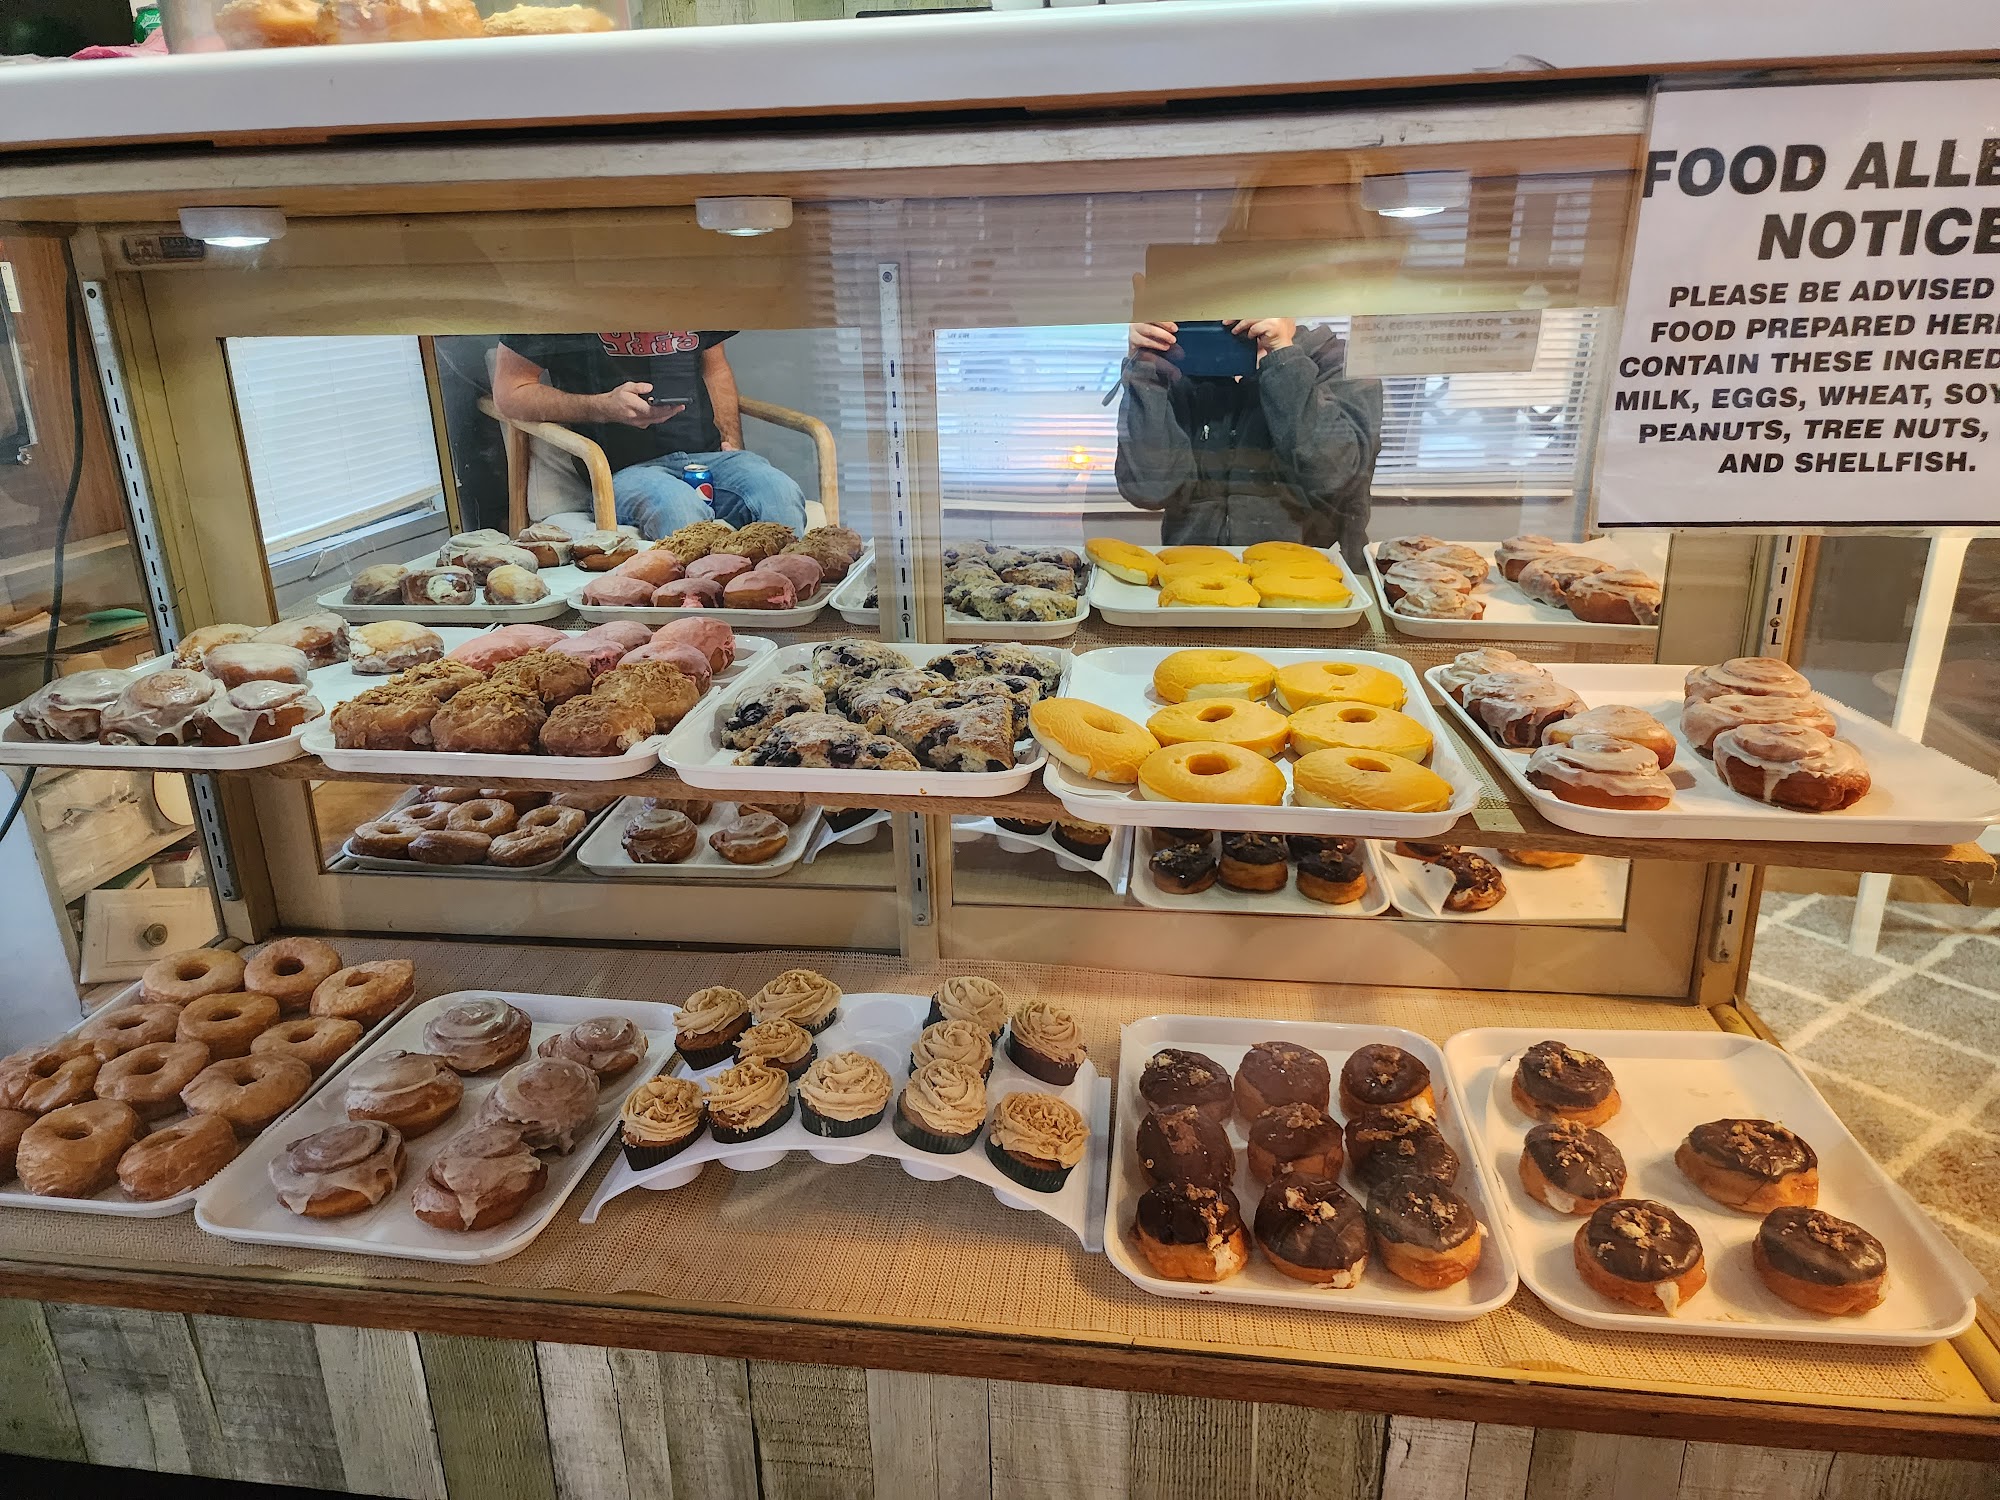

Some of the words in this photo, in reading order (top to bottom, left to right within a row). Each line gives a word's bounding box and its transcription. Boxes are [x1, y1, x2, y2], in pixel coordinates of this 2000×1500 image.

[1642, 143, 1827, 198] FOOD
[1844, 138, 2000, 190] ALLE
[1757, 206, 2000, 261] NOTICE
[1668, 282, 1789, 308] PLEASE
[1798, 281, 1841, 303] BE
[1849, 277, 1995, 301] ADVISED
[1650, 319, 1736, 343] FOOD
[1746, 314, 1916, 340] PREPARED
[1926, 313, 2000, 336] HER
[1619, 353, 1760, 378] CONTAIN
[1771, 350, 1873, 374] THESE
[1615, 389, 1700, 413] MILK,
[1711, 386, 1806, 412] EGGS,
[1818, 383, 1932, 409] WHEAT,
[1638, 419, 1791, 445] PEANUTS,
[1803, 418, 1884, 440] TREE
[1893, 417, 1989, 443] NUTS,
[1718, 452, 1784, 474] AND
[1794, 451, 1976, 474] SHELLFISH.
